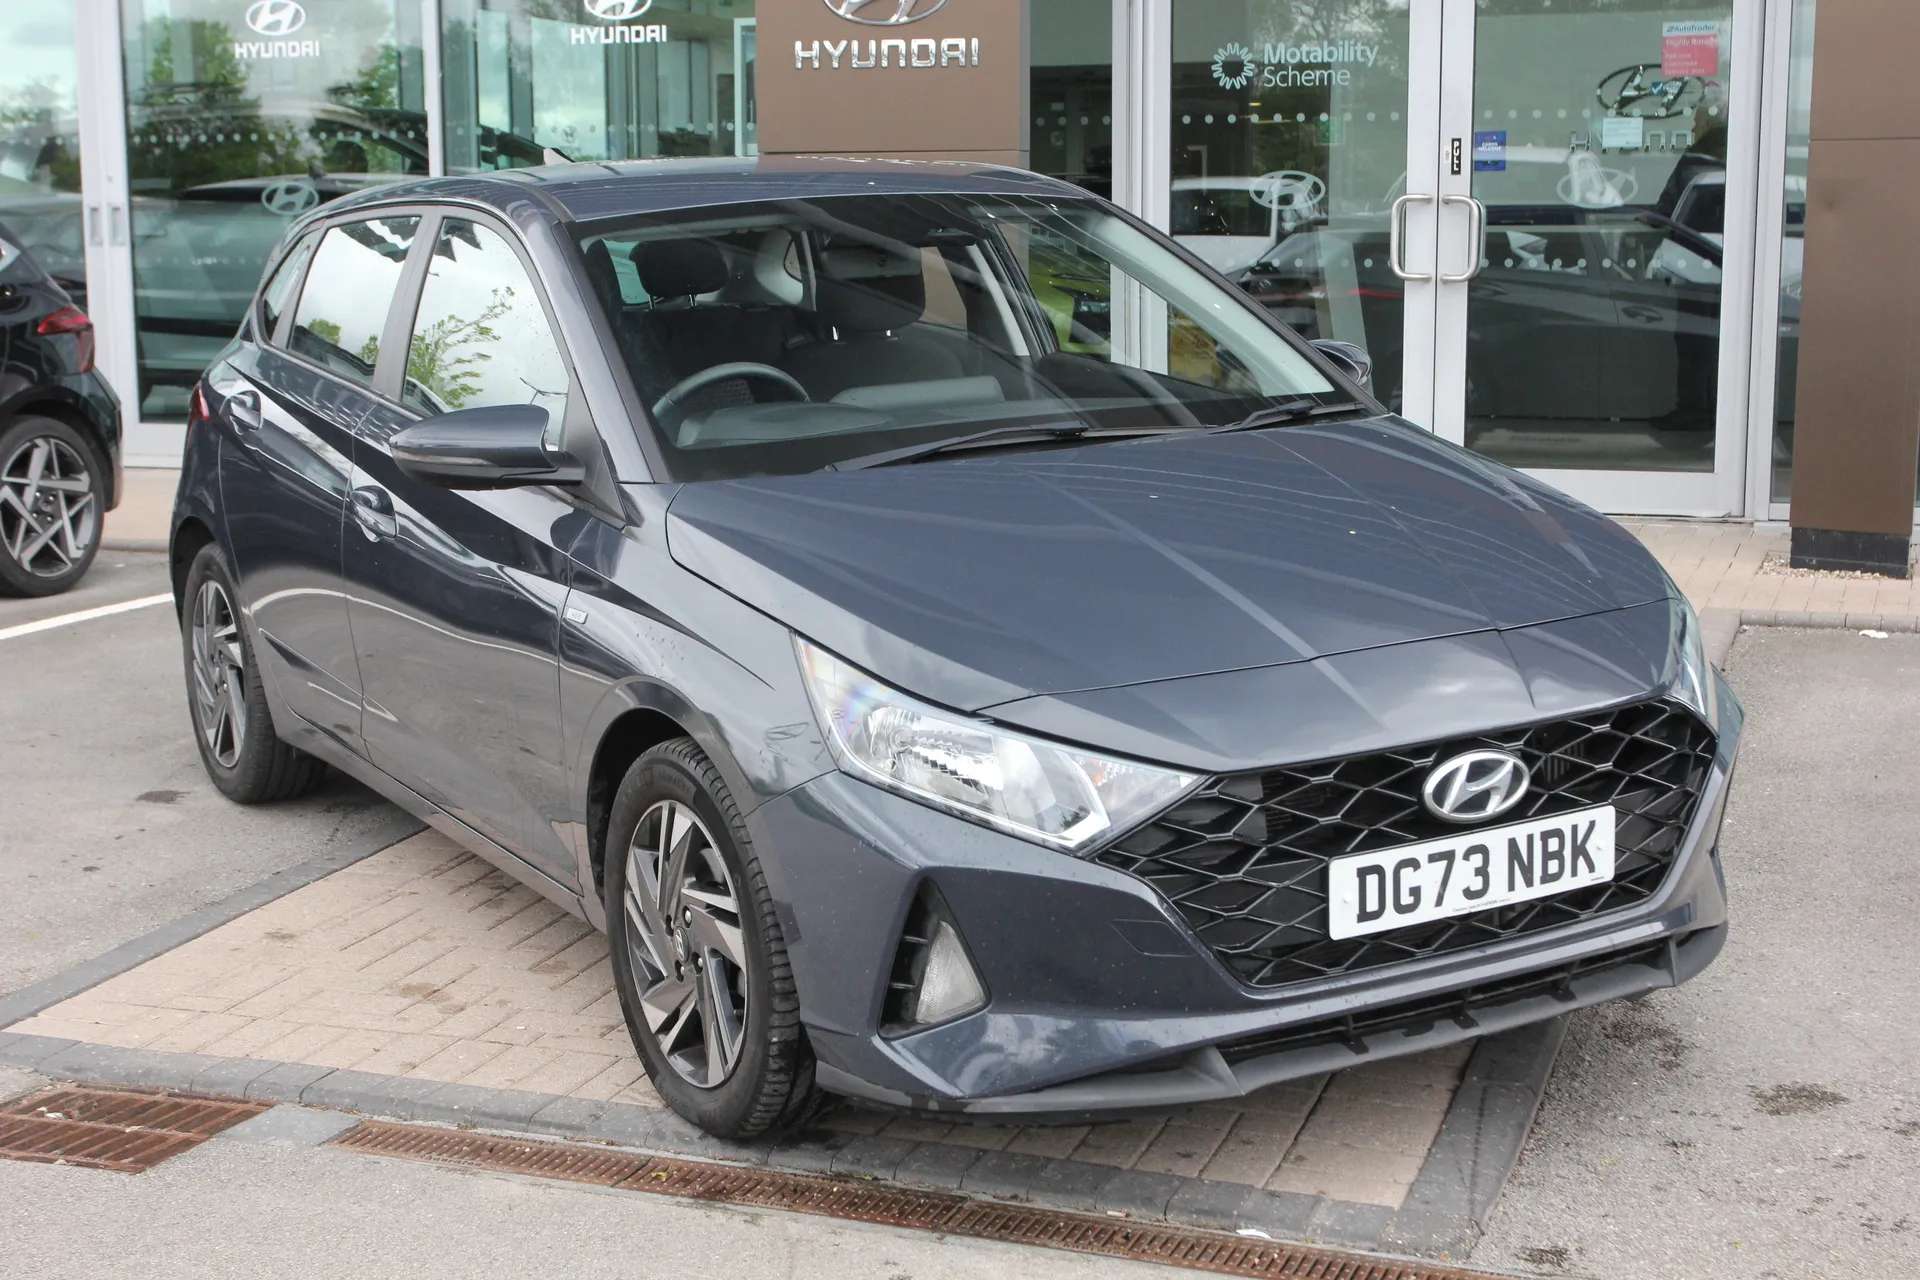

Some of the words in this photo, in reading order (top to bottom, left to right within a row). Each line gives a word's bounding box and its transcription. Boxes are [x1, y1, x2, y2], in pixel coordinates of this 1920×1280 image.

[570, 24, 668, 45] HYUNDAI
[234, 40, 320, 59] HYUNDAI
[794, 37, 980, 69] HYUNDAI
[1264, 40, 1379, 68] Motability
[1263, 65, 1351, 87] Scheme
[1452, 140, 1461, 172] PULL
[1356, 843, 1490, 923] DG73
[1507, 819, 1597, 893] NBK
